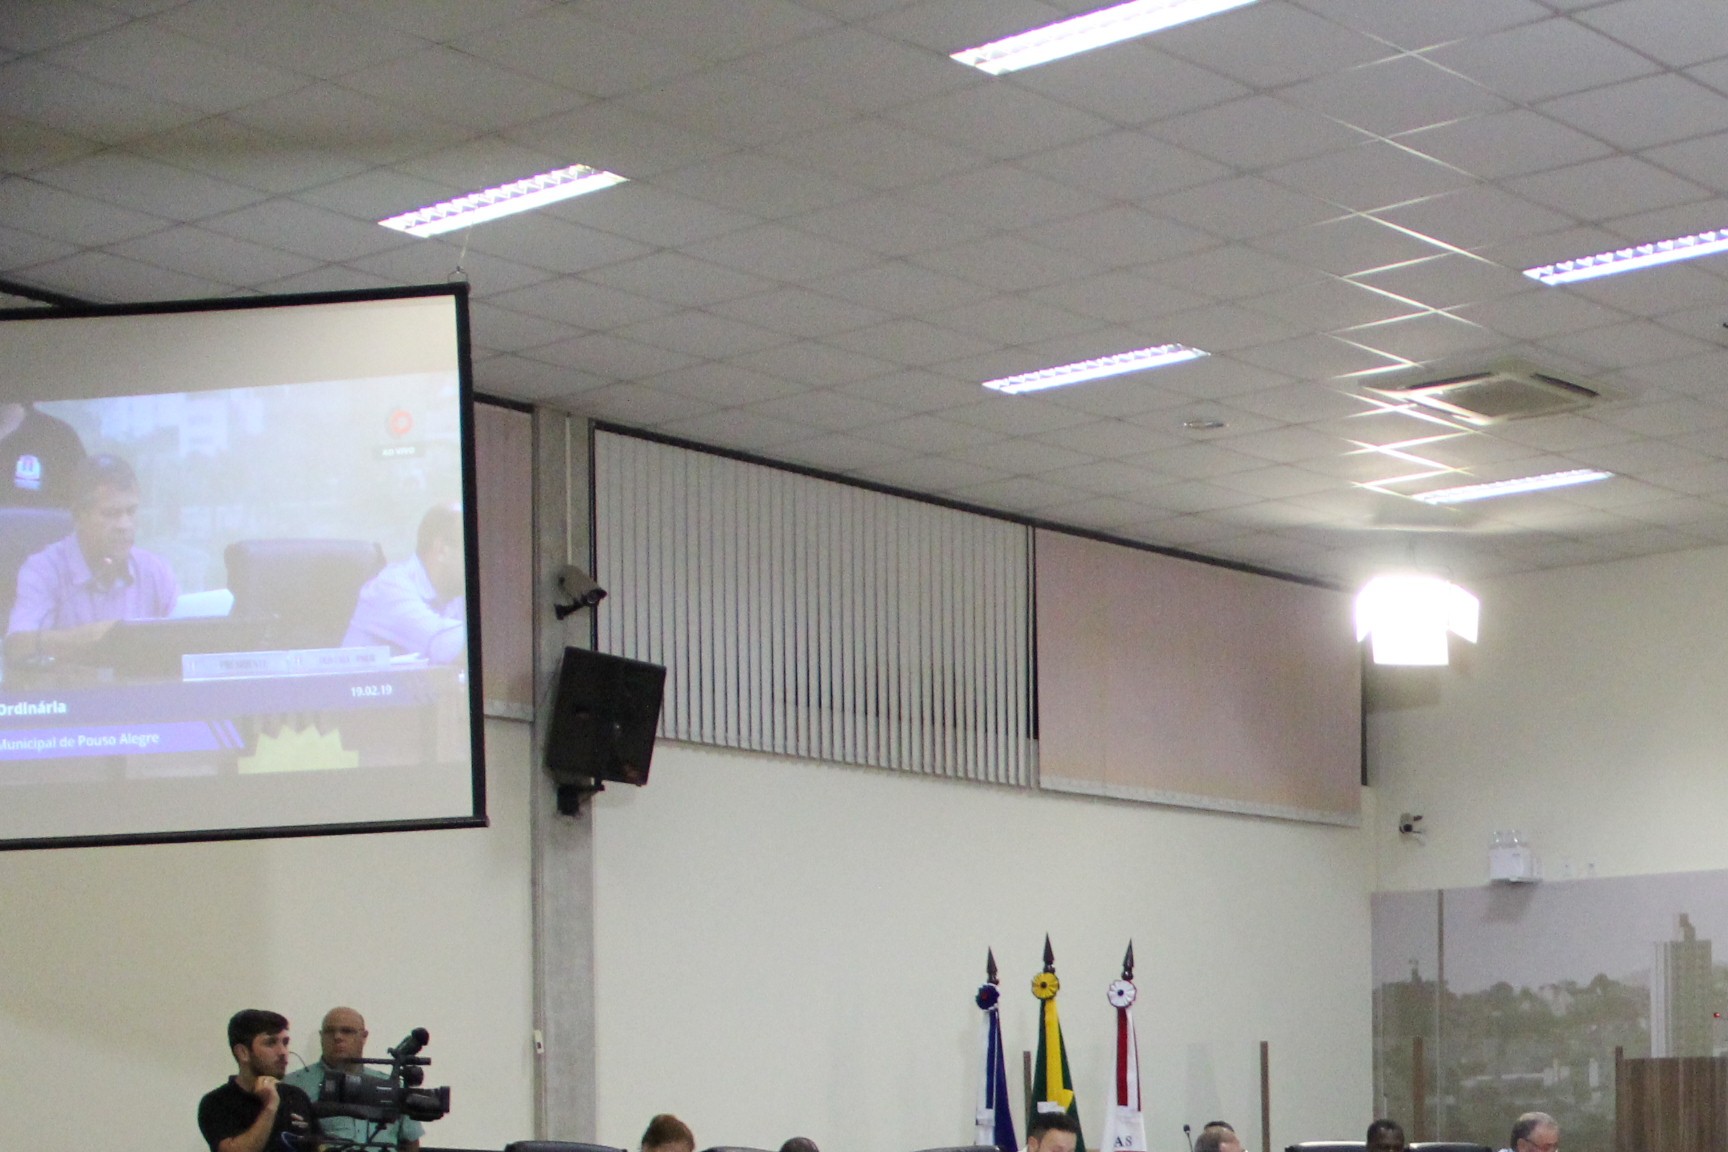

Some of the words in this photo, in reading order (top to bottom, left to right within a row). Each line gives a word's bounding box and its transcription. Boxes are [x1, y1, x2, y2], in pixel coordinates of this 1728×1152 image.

[350, 684, 393, 697] 19.02.19
[60, 736, 75, 748] de
[77, 734, 116, 747] Pouso
[120, 733, 160, 748] Alegre
